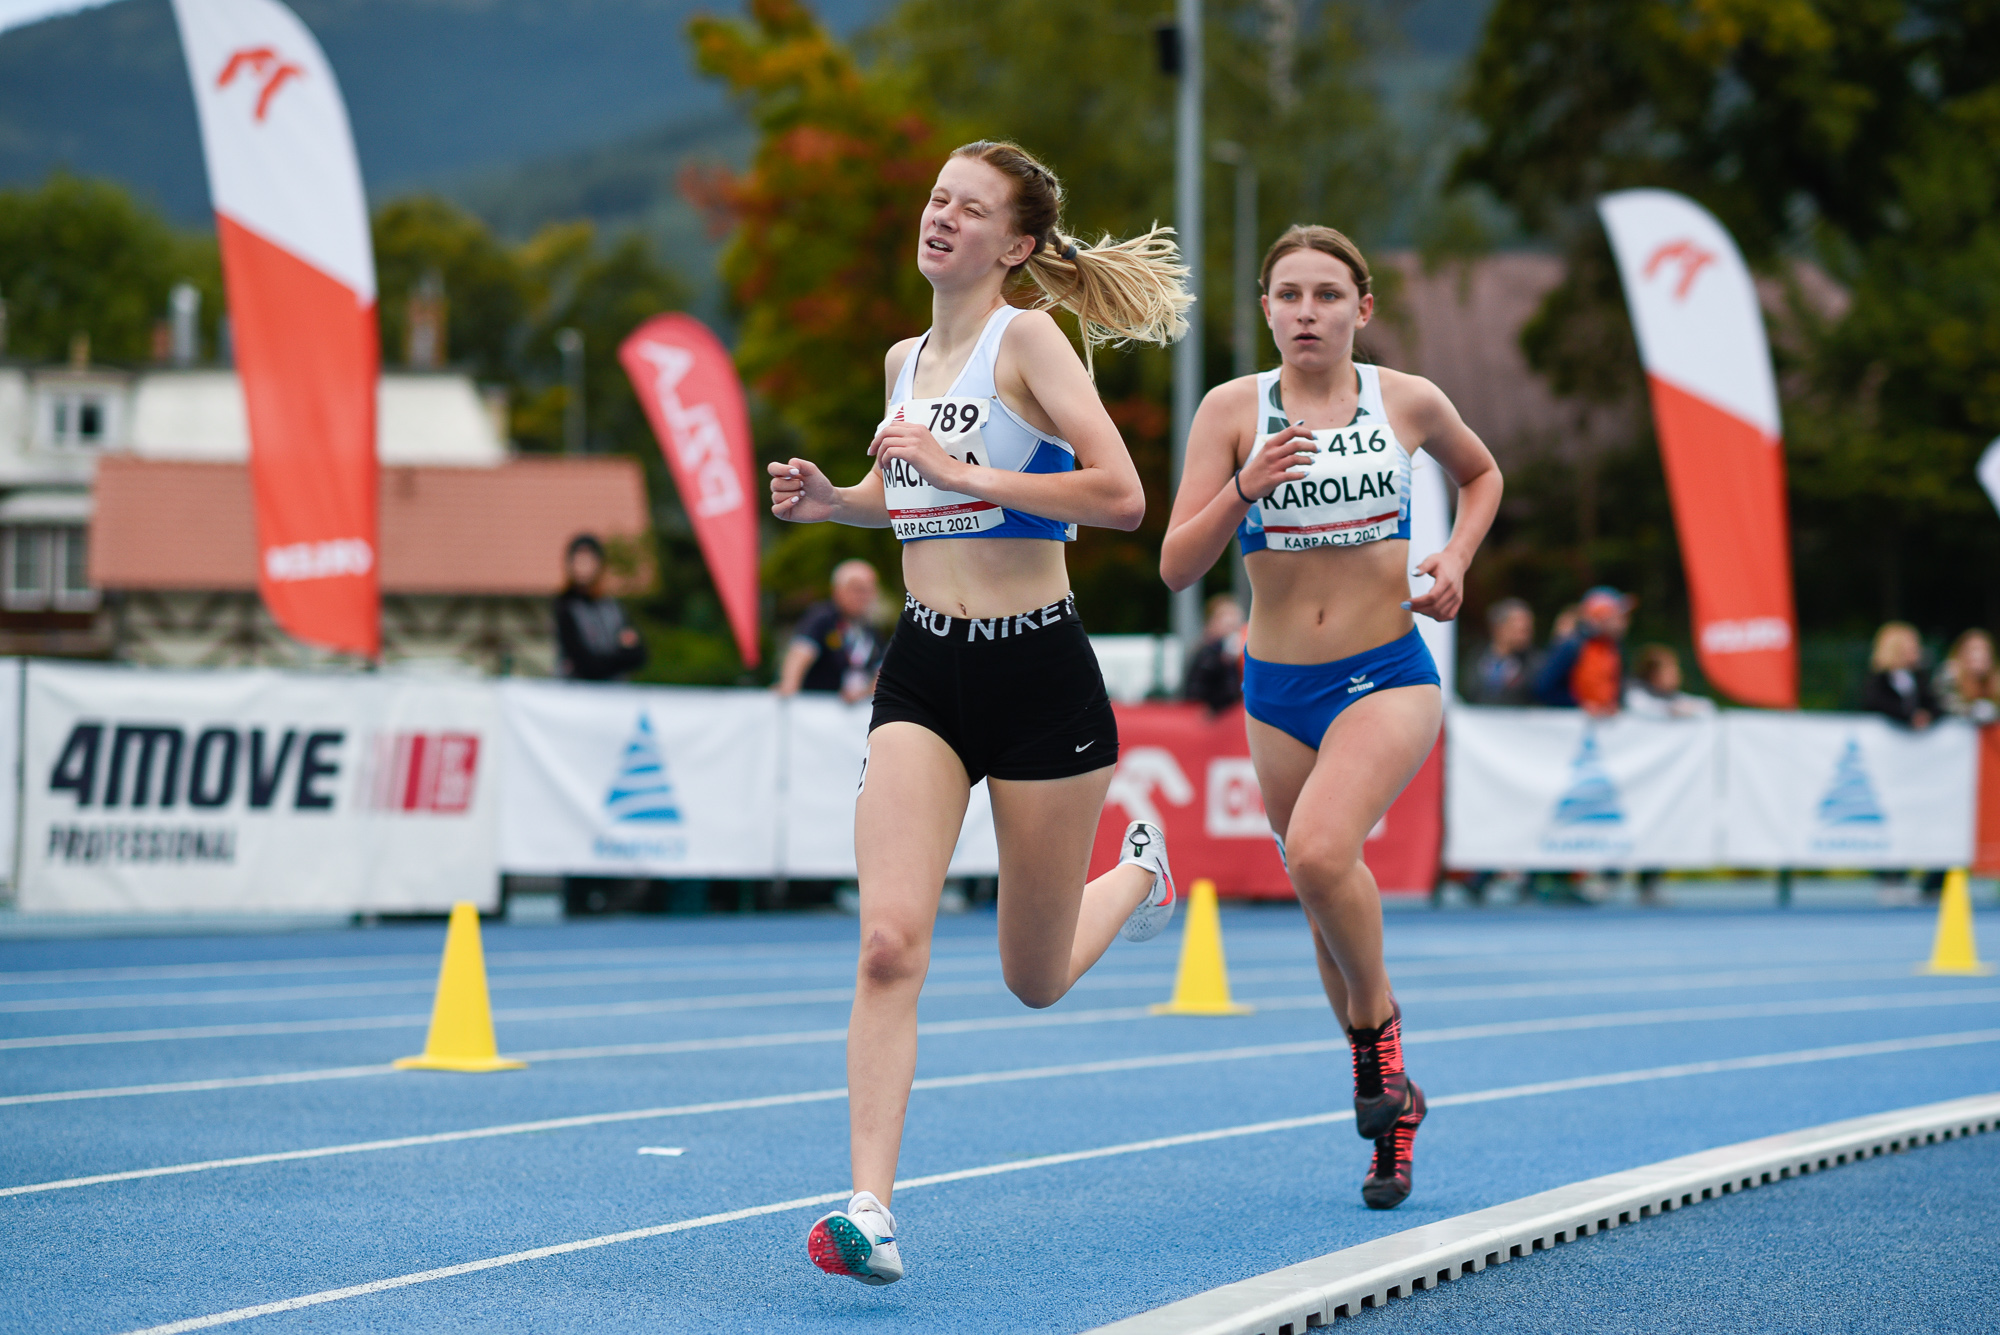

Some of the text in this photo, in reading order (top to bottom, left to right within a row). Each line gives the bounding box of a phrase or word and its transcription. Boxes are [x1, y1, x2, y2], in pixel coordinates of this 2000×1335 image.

[929, 403, 979, 433] 789
[1328, 430, 1386, 456] 416
[1262, 471, 1395, 510] KAROLAK
[947, 516, 980, 532] 2021
[1284, 533, 1350, 549] KARPACZ
[1354, 526, 1381, 543] 2021
[967, 602, 1062, 642] NIKE
[49, 724, 344, 810] 4MOVE
[48, 827, 236, 863] PROFESSIONAL
